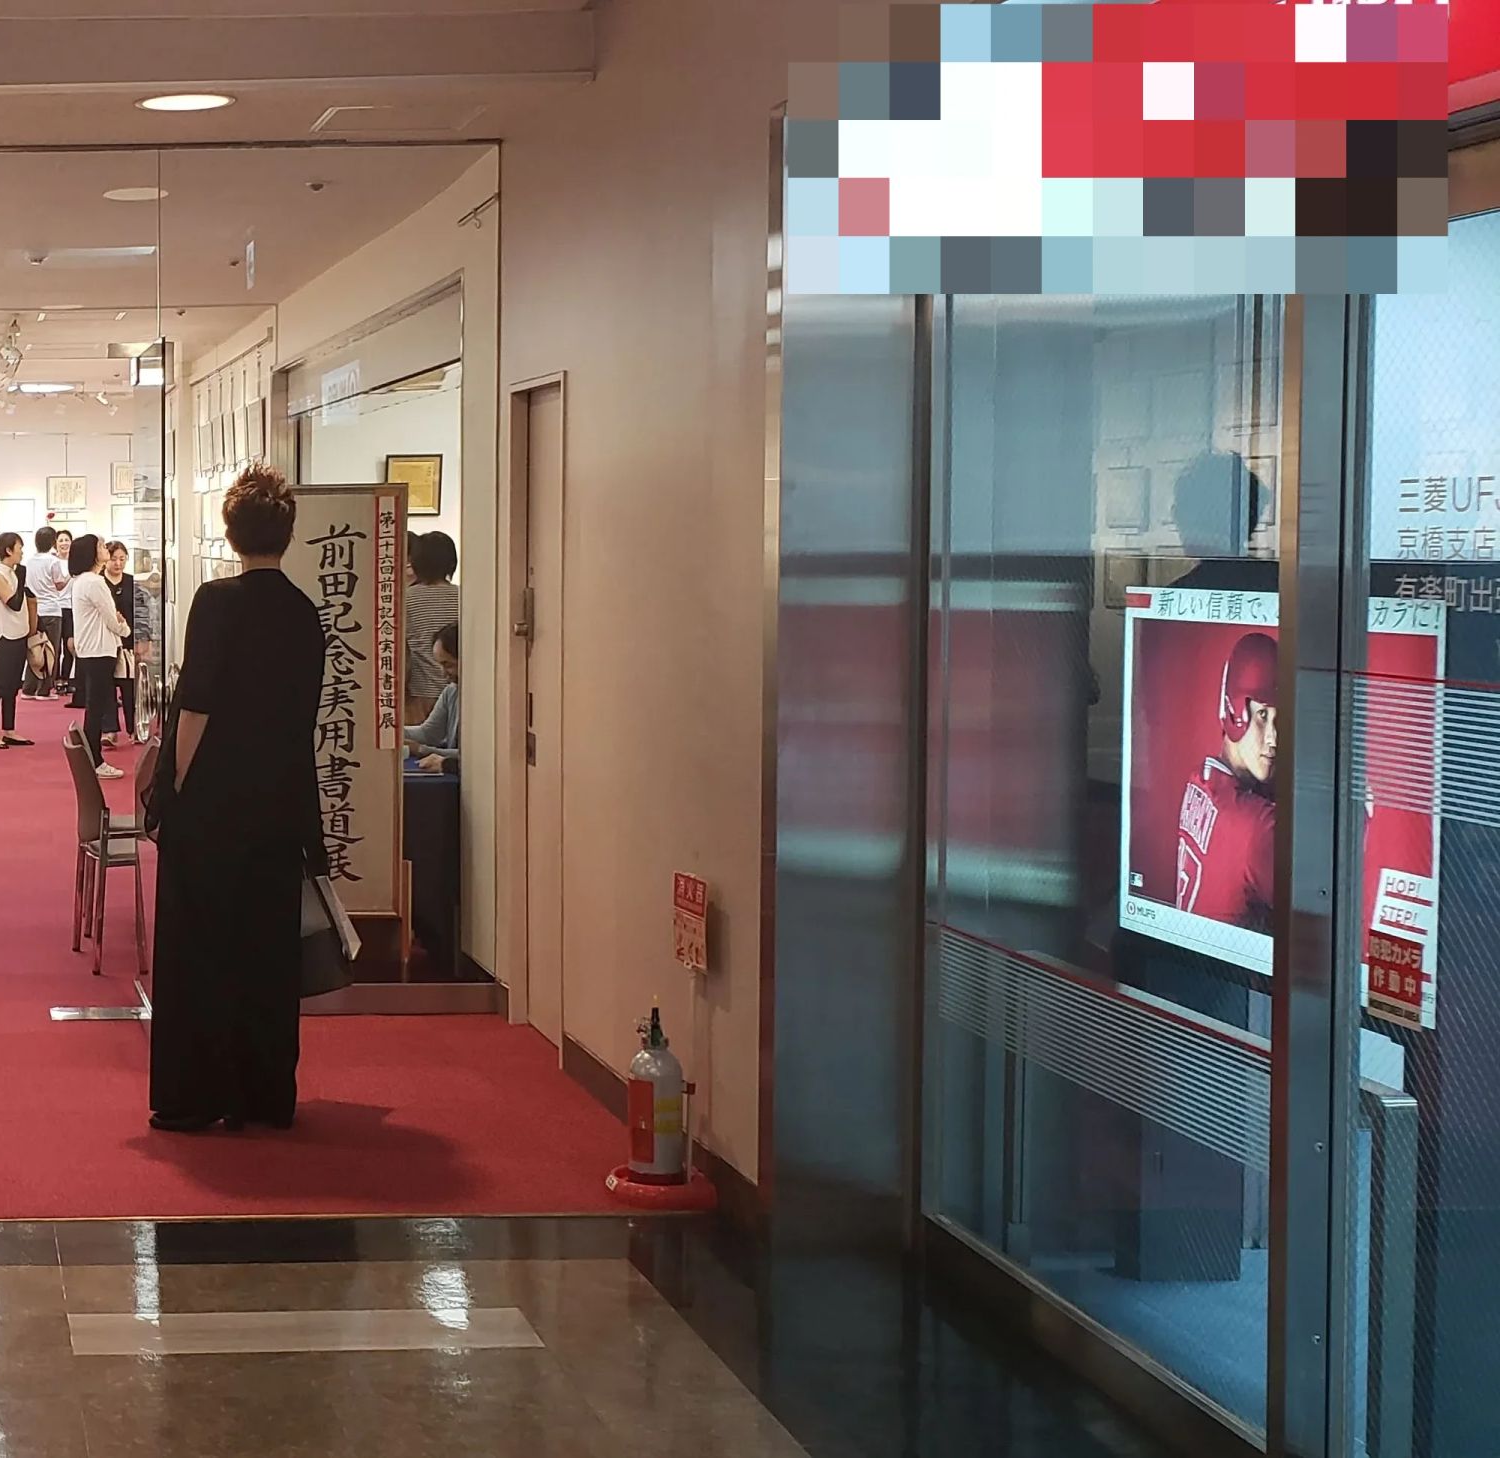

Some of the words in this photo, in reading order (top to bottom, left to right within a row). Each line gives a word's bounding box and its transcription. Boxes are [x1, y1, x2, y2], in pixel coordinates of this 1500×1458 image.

[1397, 525, 1497, 561] 京橋支店
[378, 511, 398, 729] 第二十六回前田記念実用書道展
[305, 523, 368, 882] 前田記念実用書道展
[1385, 876, 1421, 897] HOP!
[1379, 905, 1418, 926] STEP!
